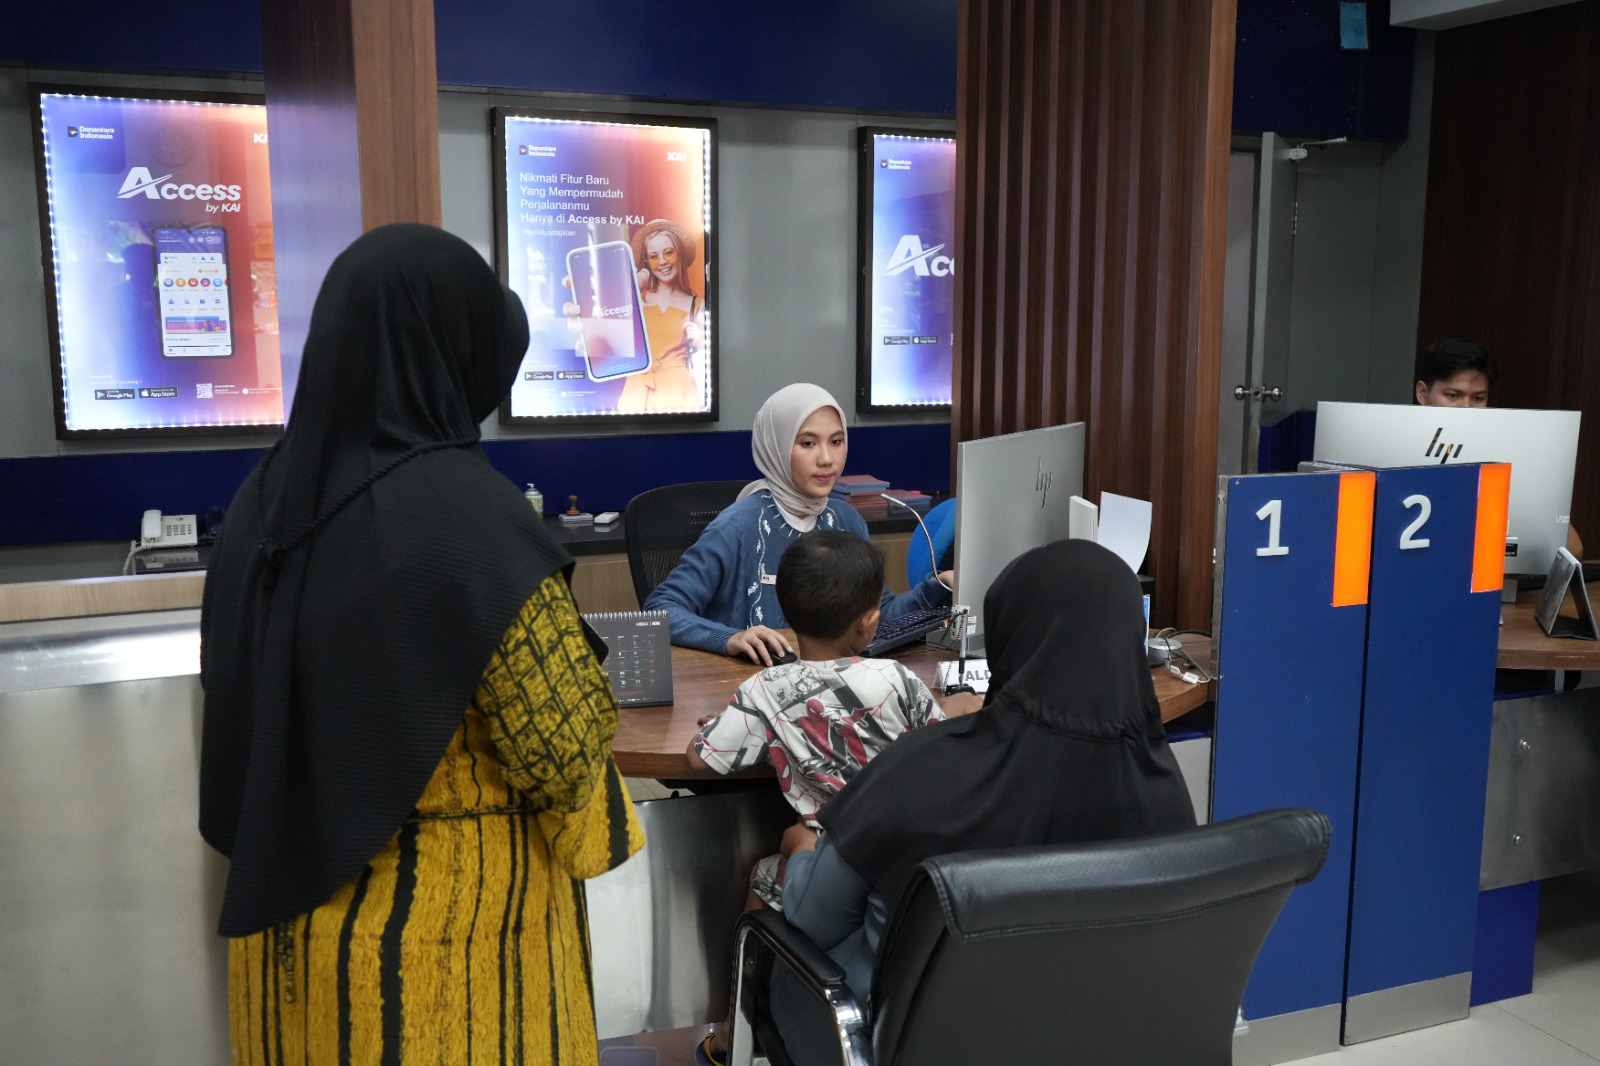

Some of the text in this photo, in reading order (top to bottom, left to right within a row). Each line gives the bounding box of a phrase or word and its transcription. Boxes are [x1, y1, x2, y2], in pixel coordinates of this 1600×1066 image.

[116, 166, 241, 200] Access
[520, 173, 609, 185] Nikmati Fitur Baru
[520, 186, 624, 198] Yang Mempermudah
[205, 203, 240, 214] by KAI
[521, 199, 590, 211] Perjalananmu
[521, 213, 645, 227] Hanya di Access by KAI
[884, 234, 954, 277] Ac
[1255, 499, 1290, 557] 1
[1400, 494, 1432, 550] 2
